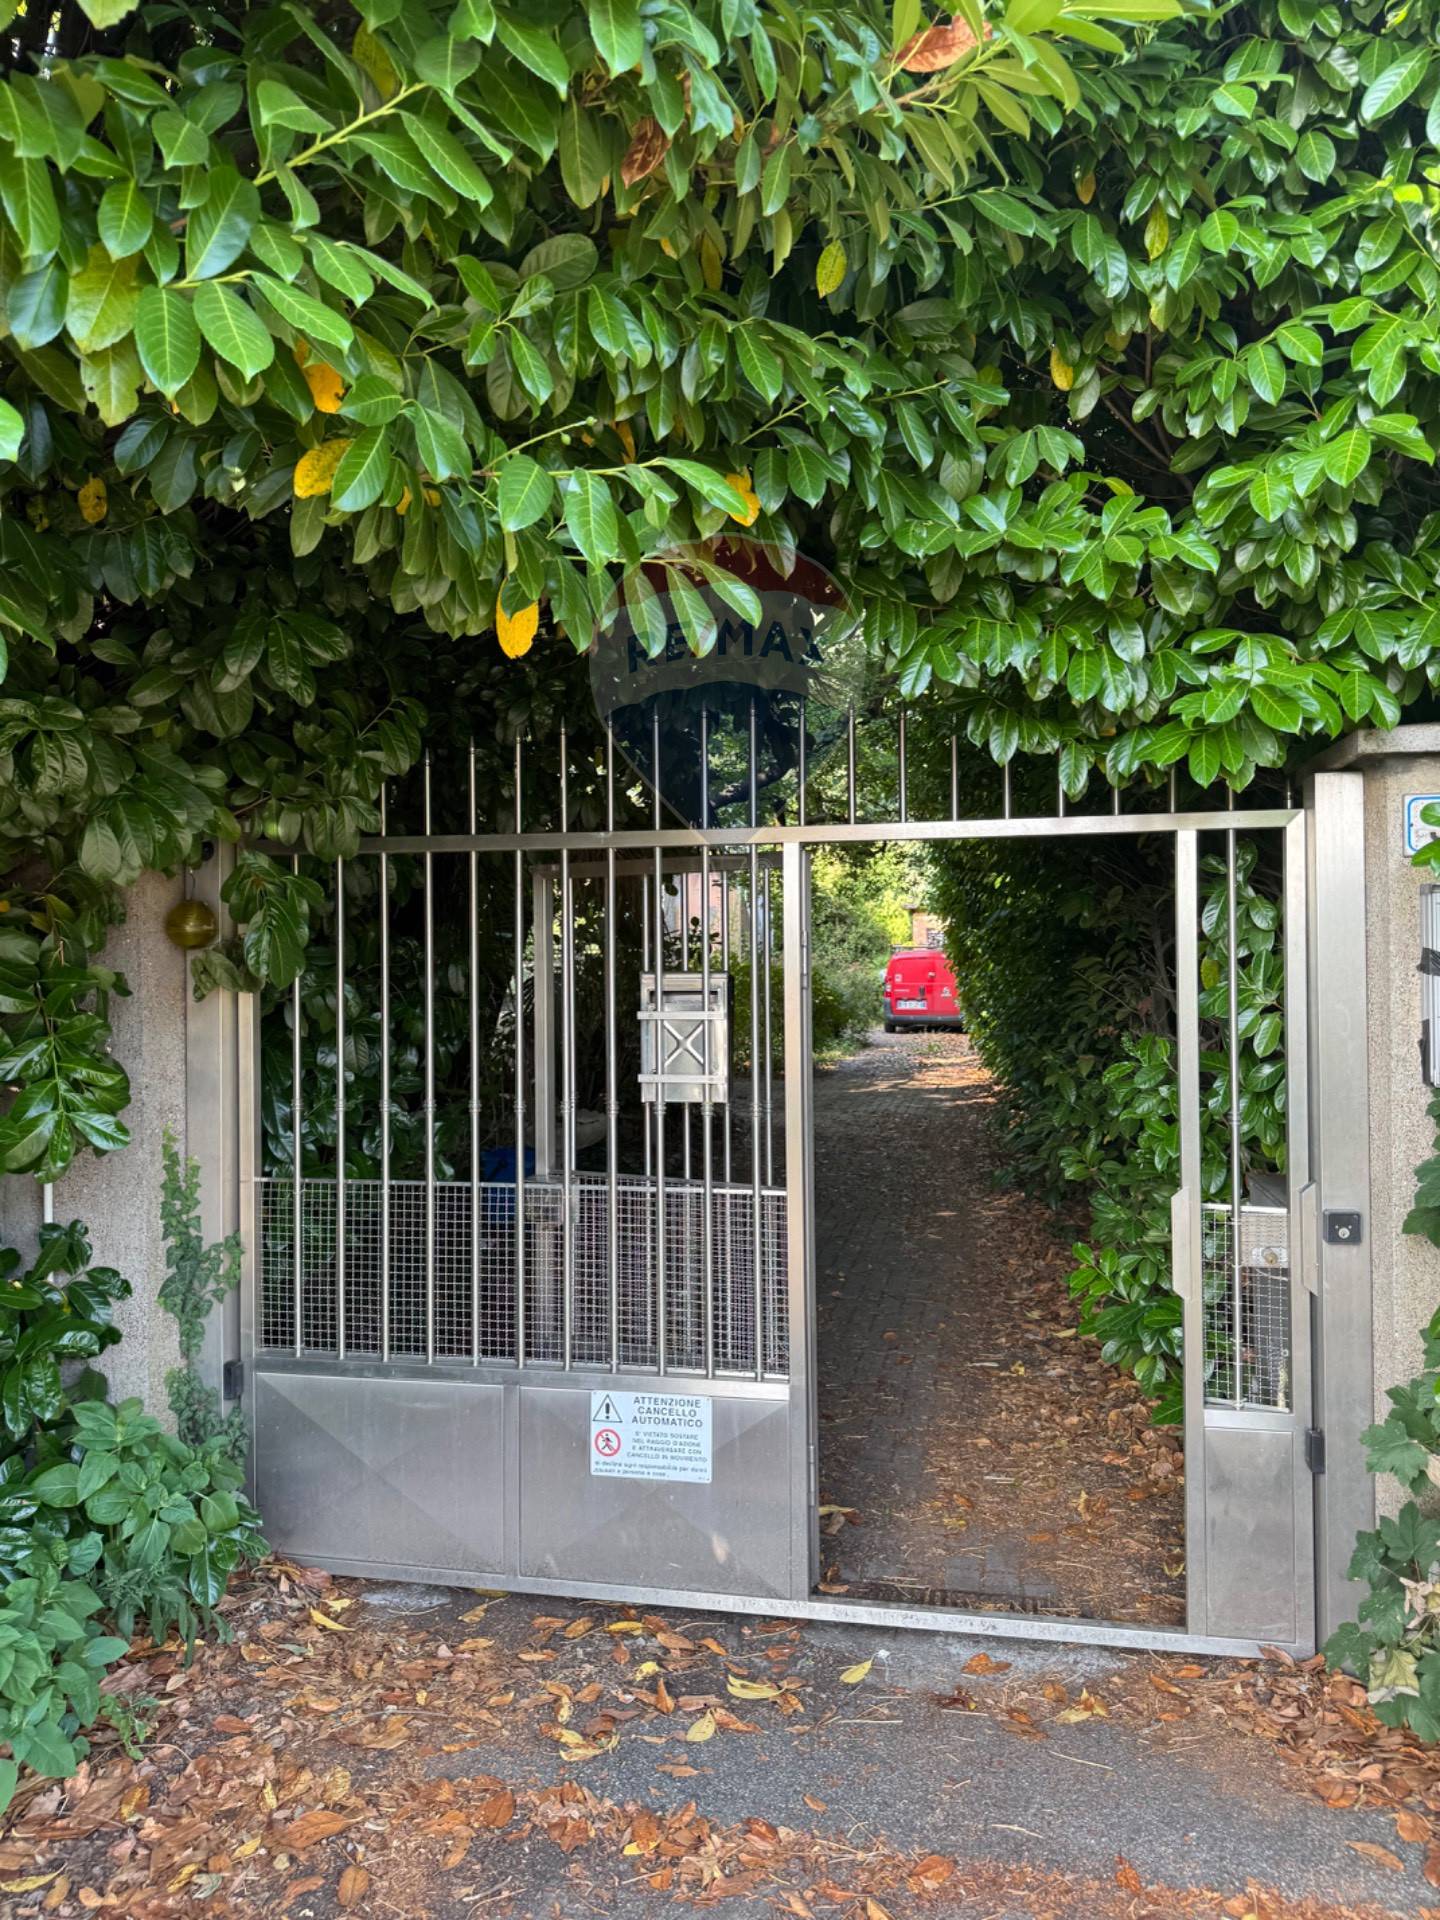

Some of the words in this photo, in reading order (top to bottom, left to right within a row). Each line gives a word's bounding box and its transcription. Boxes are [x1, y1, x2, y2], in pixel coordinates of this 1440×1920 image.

[633, 1396, 702, 1409] ATTENZIONE
[637, 1406, 697, 1418] CANCELLO
[632, 1415, 703, 1428] AUTOMATICO
[643, 1431, 669, 1439] VIETATO
[670, 1432, 699, 1440] SOSTARE
[646, 1438, 671, 1446] RAGGIO
[638, 1445, 686, 1454] ATTRAVERSARE
[626, 1452, 660, 1460] CANCELLO
[670, 1455, 708, 1463] MOVIMENTO
